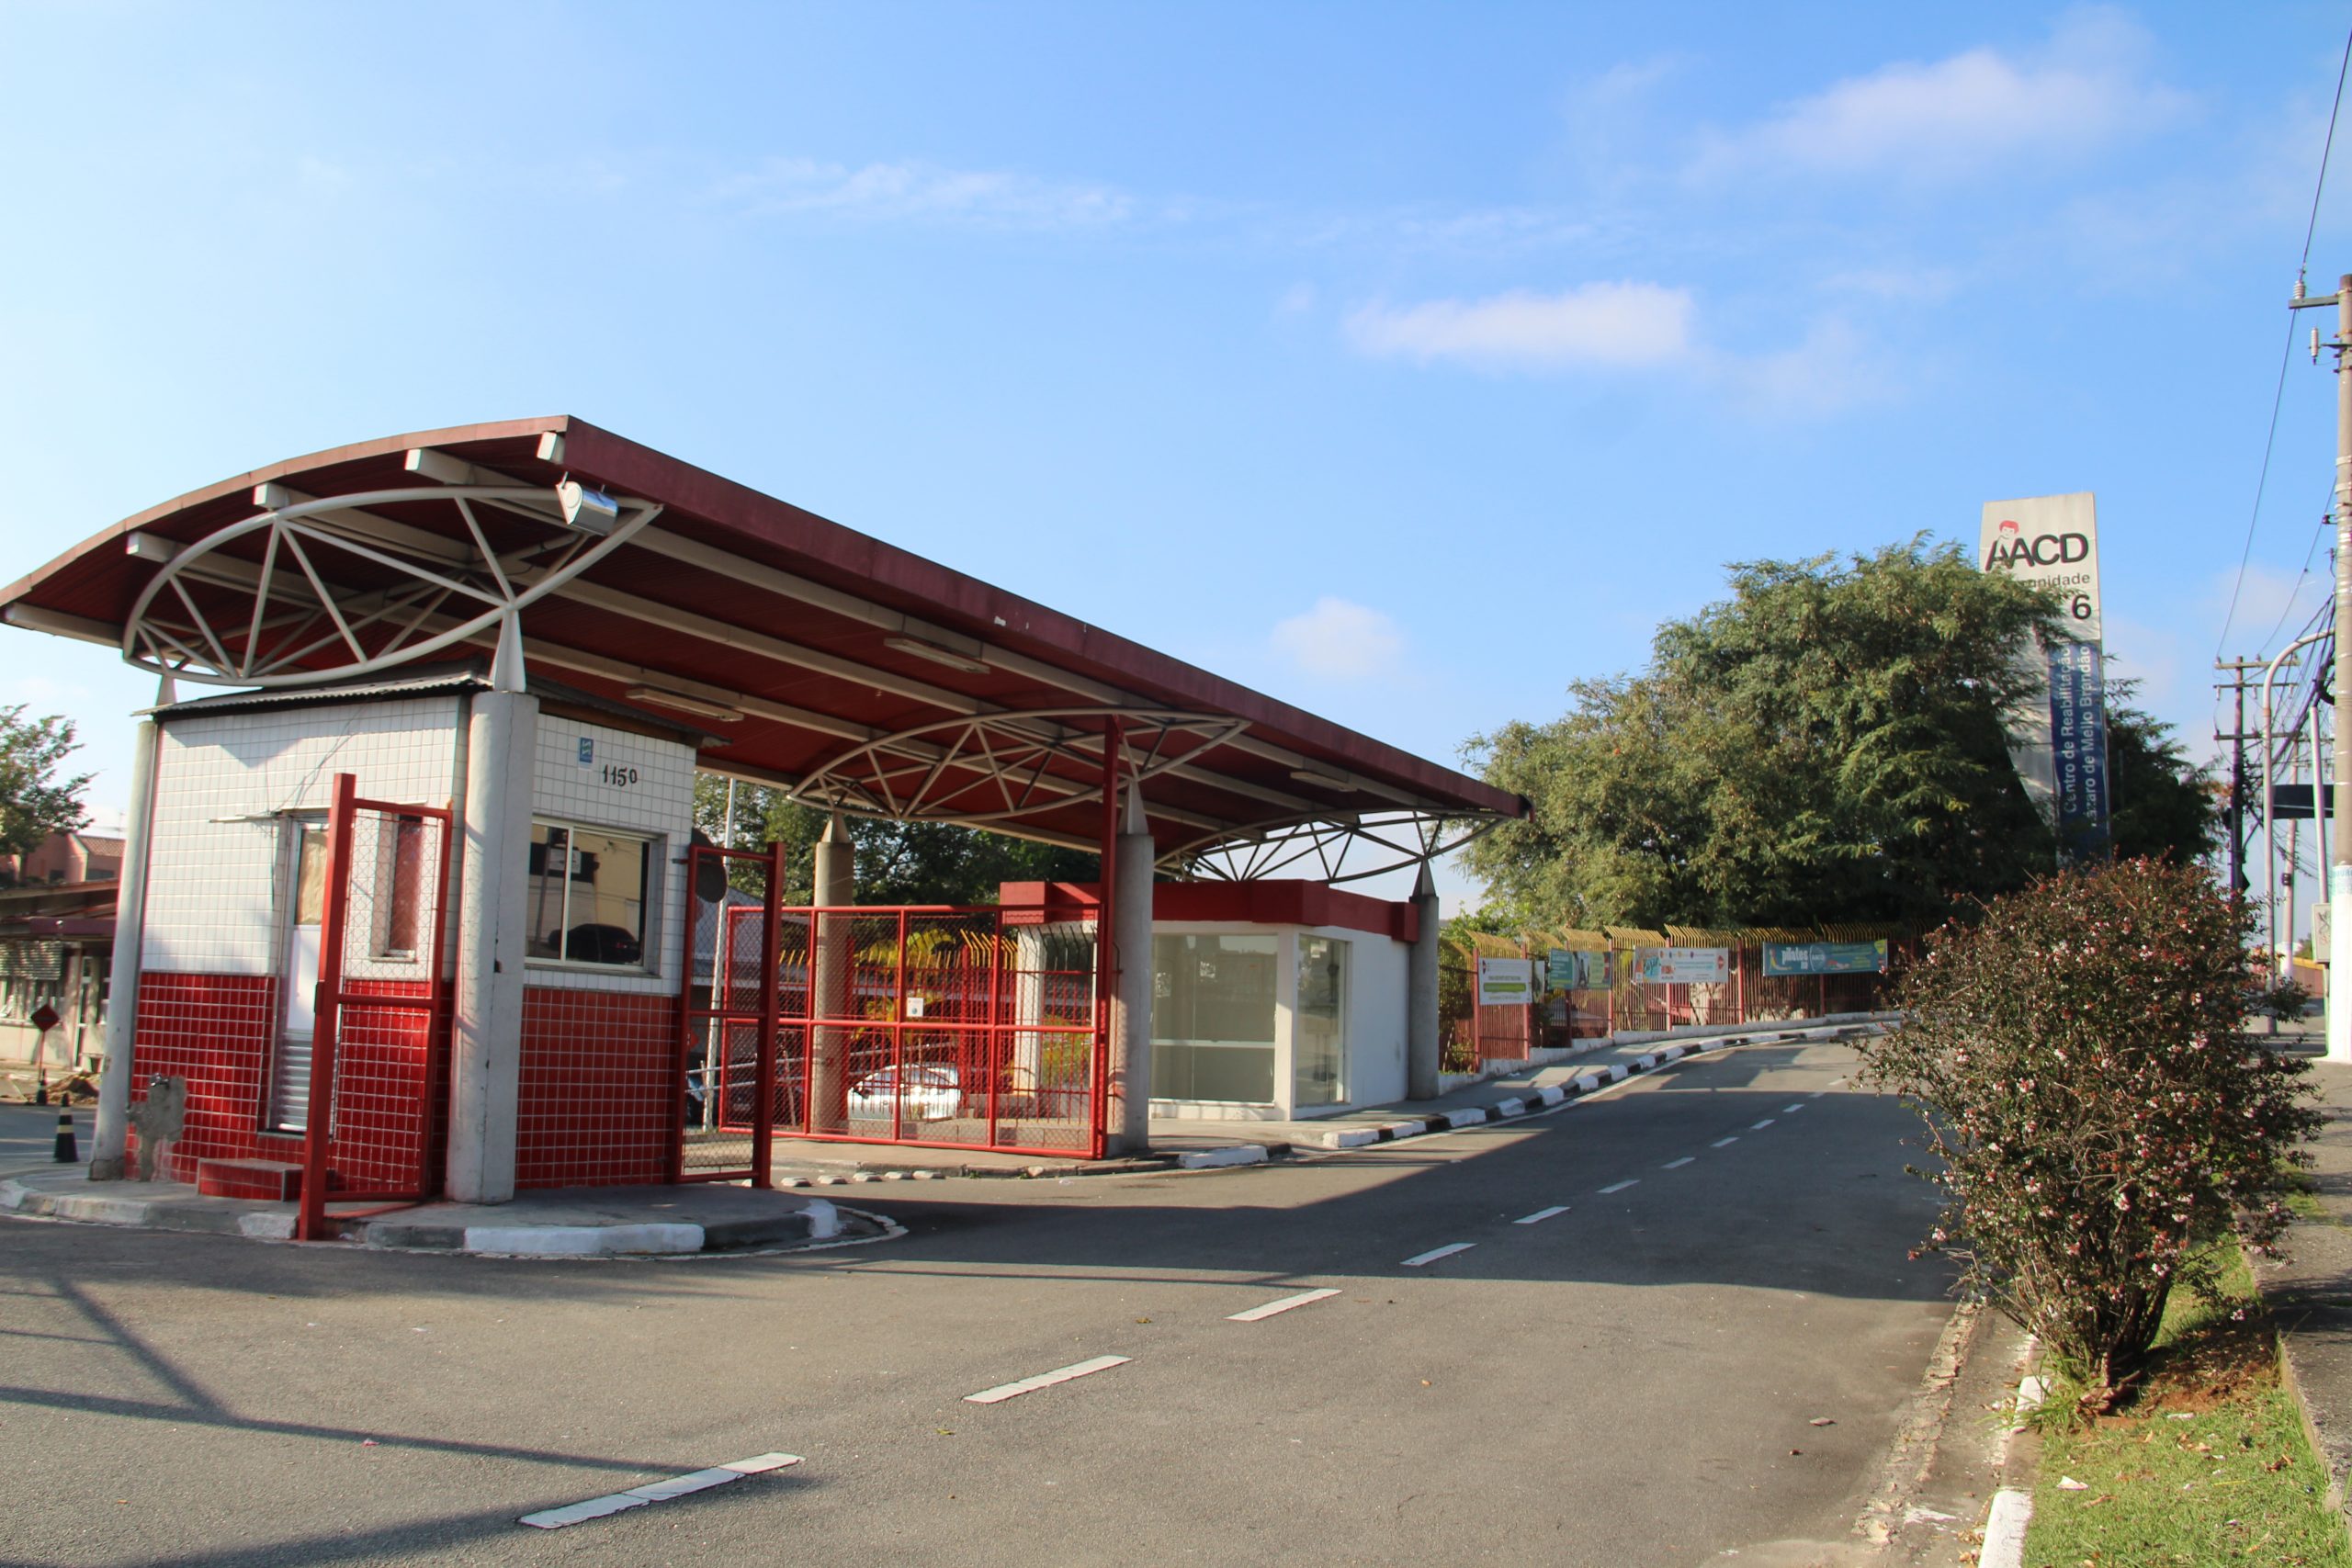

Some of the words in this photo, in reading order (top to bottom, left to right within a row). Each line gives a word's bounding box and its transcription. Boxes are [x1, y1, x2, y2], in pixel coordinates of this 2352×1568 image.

[1984, 533, 2088, 571] AACD
[2076, 646, 2092, 706] Brandão
[2061, 740, 2075, 760] de
[2080, 711, 2094, 751] Mello
[603, 764, 638, 786] 1150
[2082, 755, 2095, 773] de
[2064, 763, 2076, 813] Centro
[2082, 777, 2097, 827] ázaro
